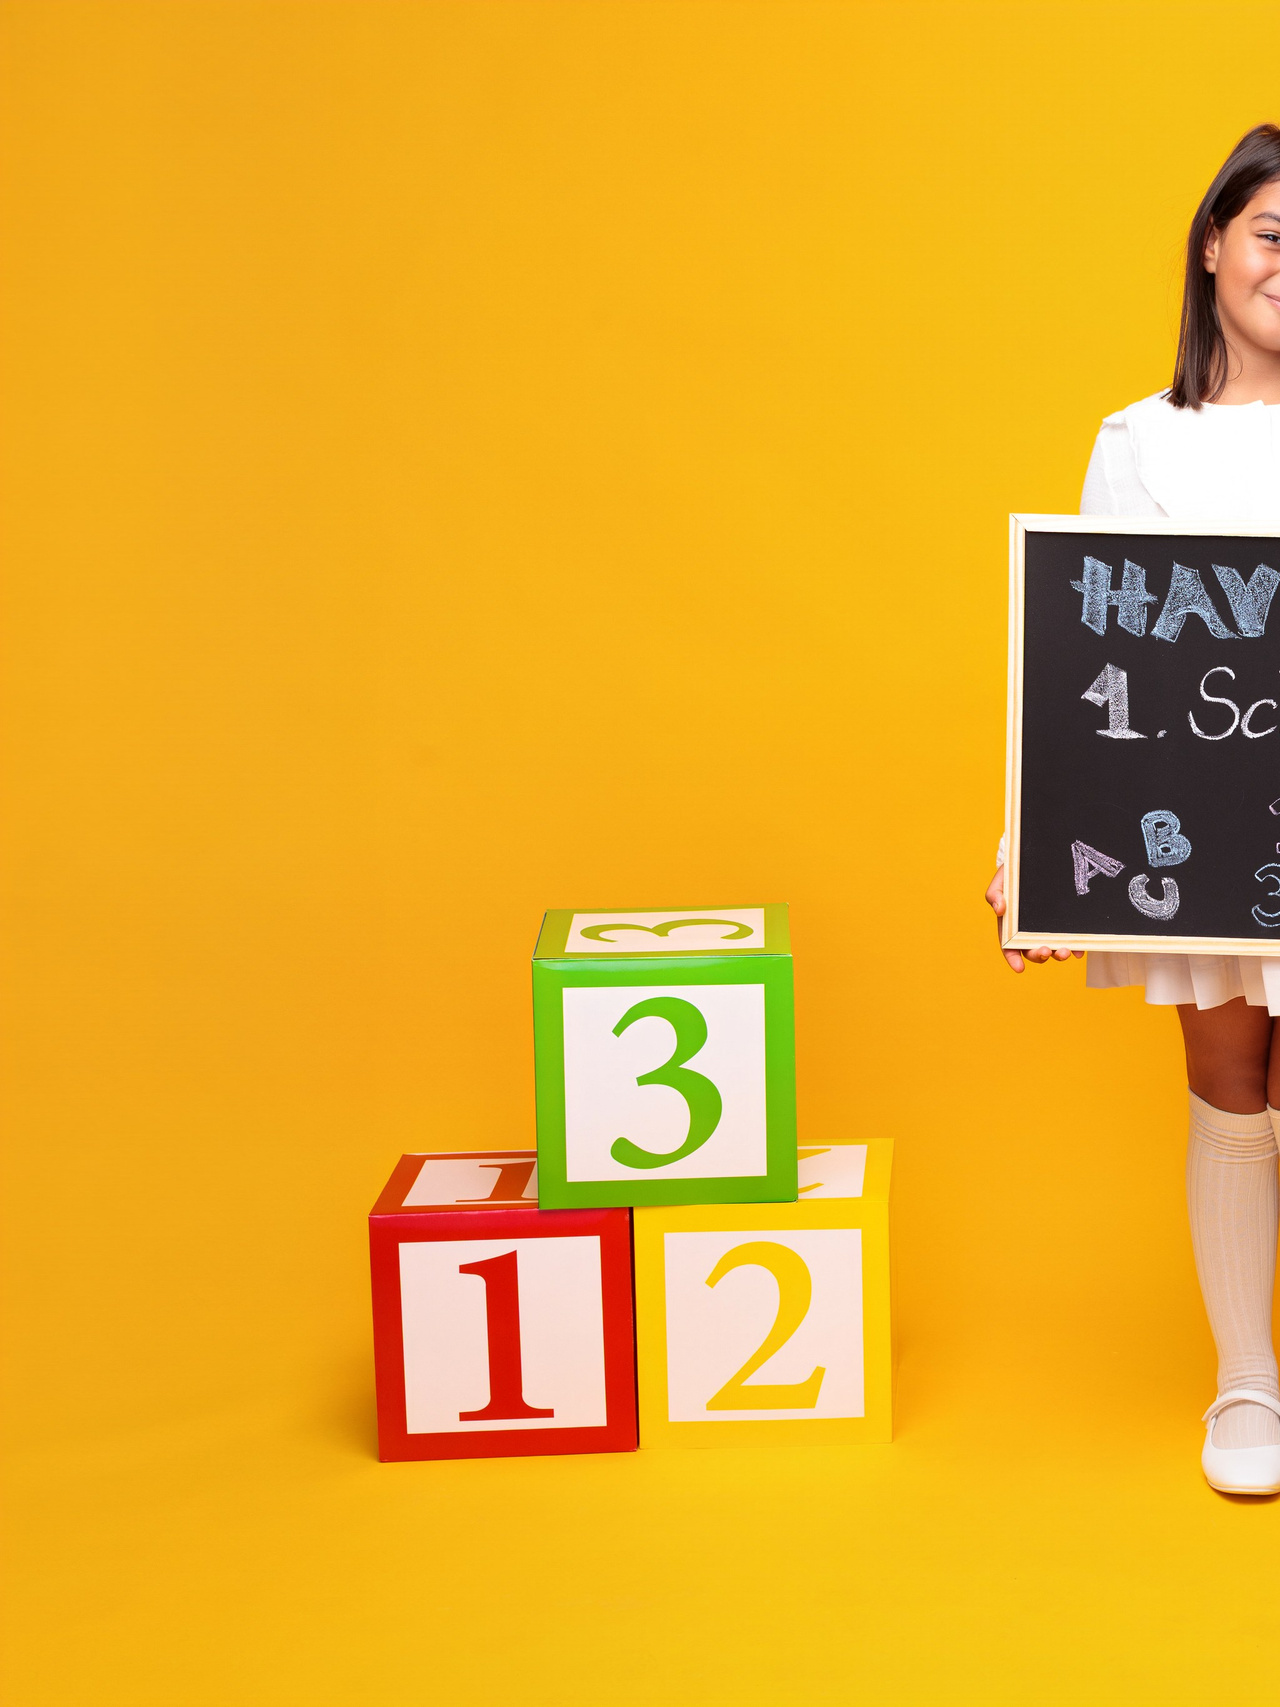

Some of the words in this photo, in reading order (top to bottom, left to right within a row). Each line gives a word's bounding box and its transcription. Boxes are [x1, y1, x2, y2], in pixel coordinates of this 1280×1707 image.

[1080, 662, 1168, 739] 1.
[1071, 839, 1127, 896] A
[1140, 809, 1193, 868] B
[579, 917, 754, 943] 3
[1127, 873, 1181, 921] C
[610, 996, 723, 1170] 3
[458, 1249, 555, 1422] 1
[704, 1240, 827, 1412] 2
